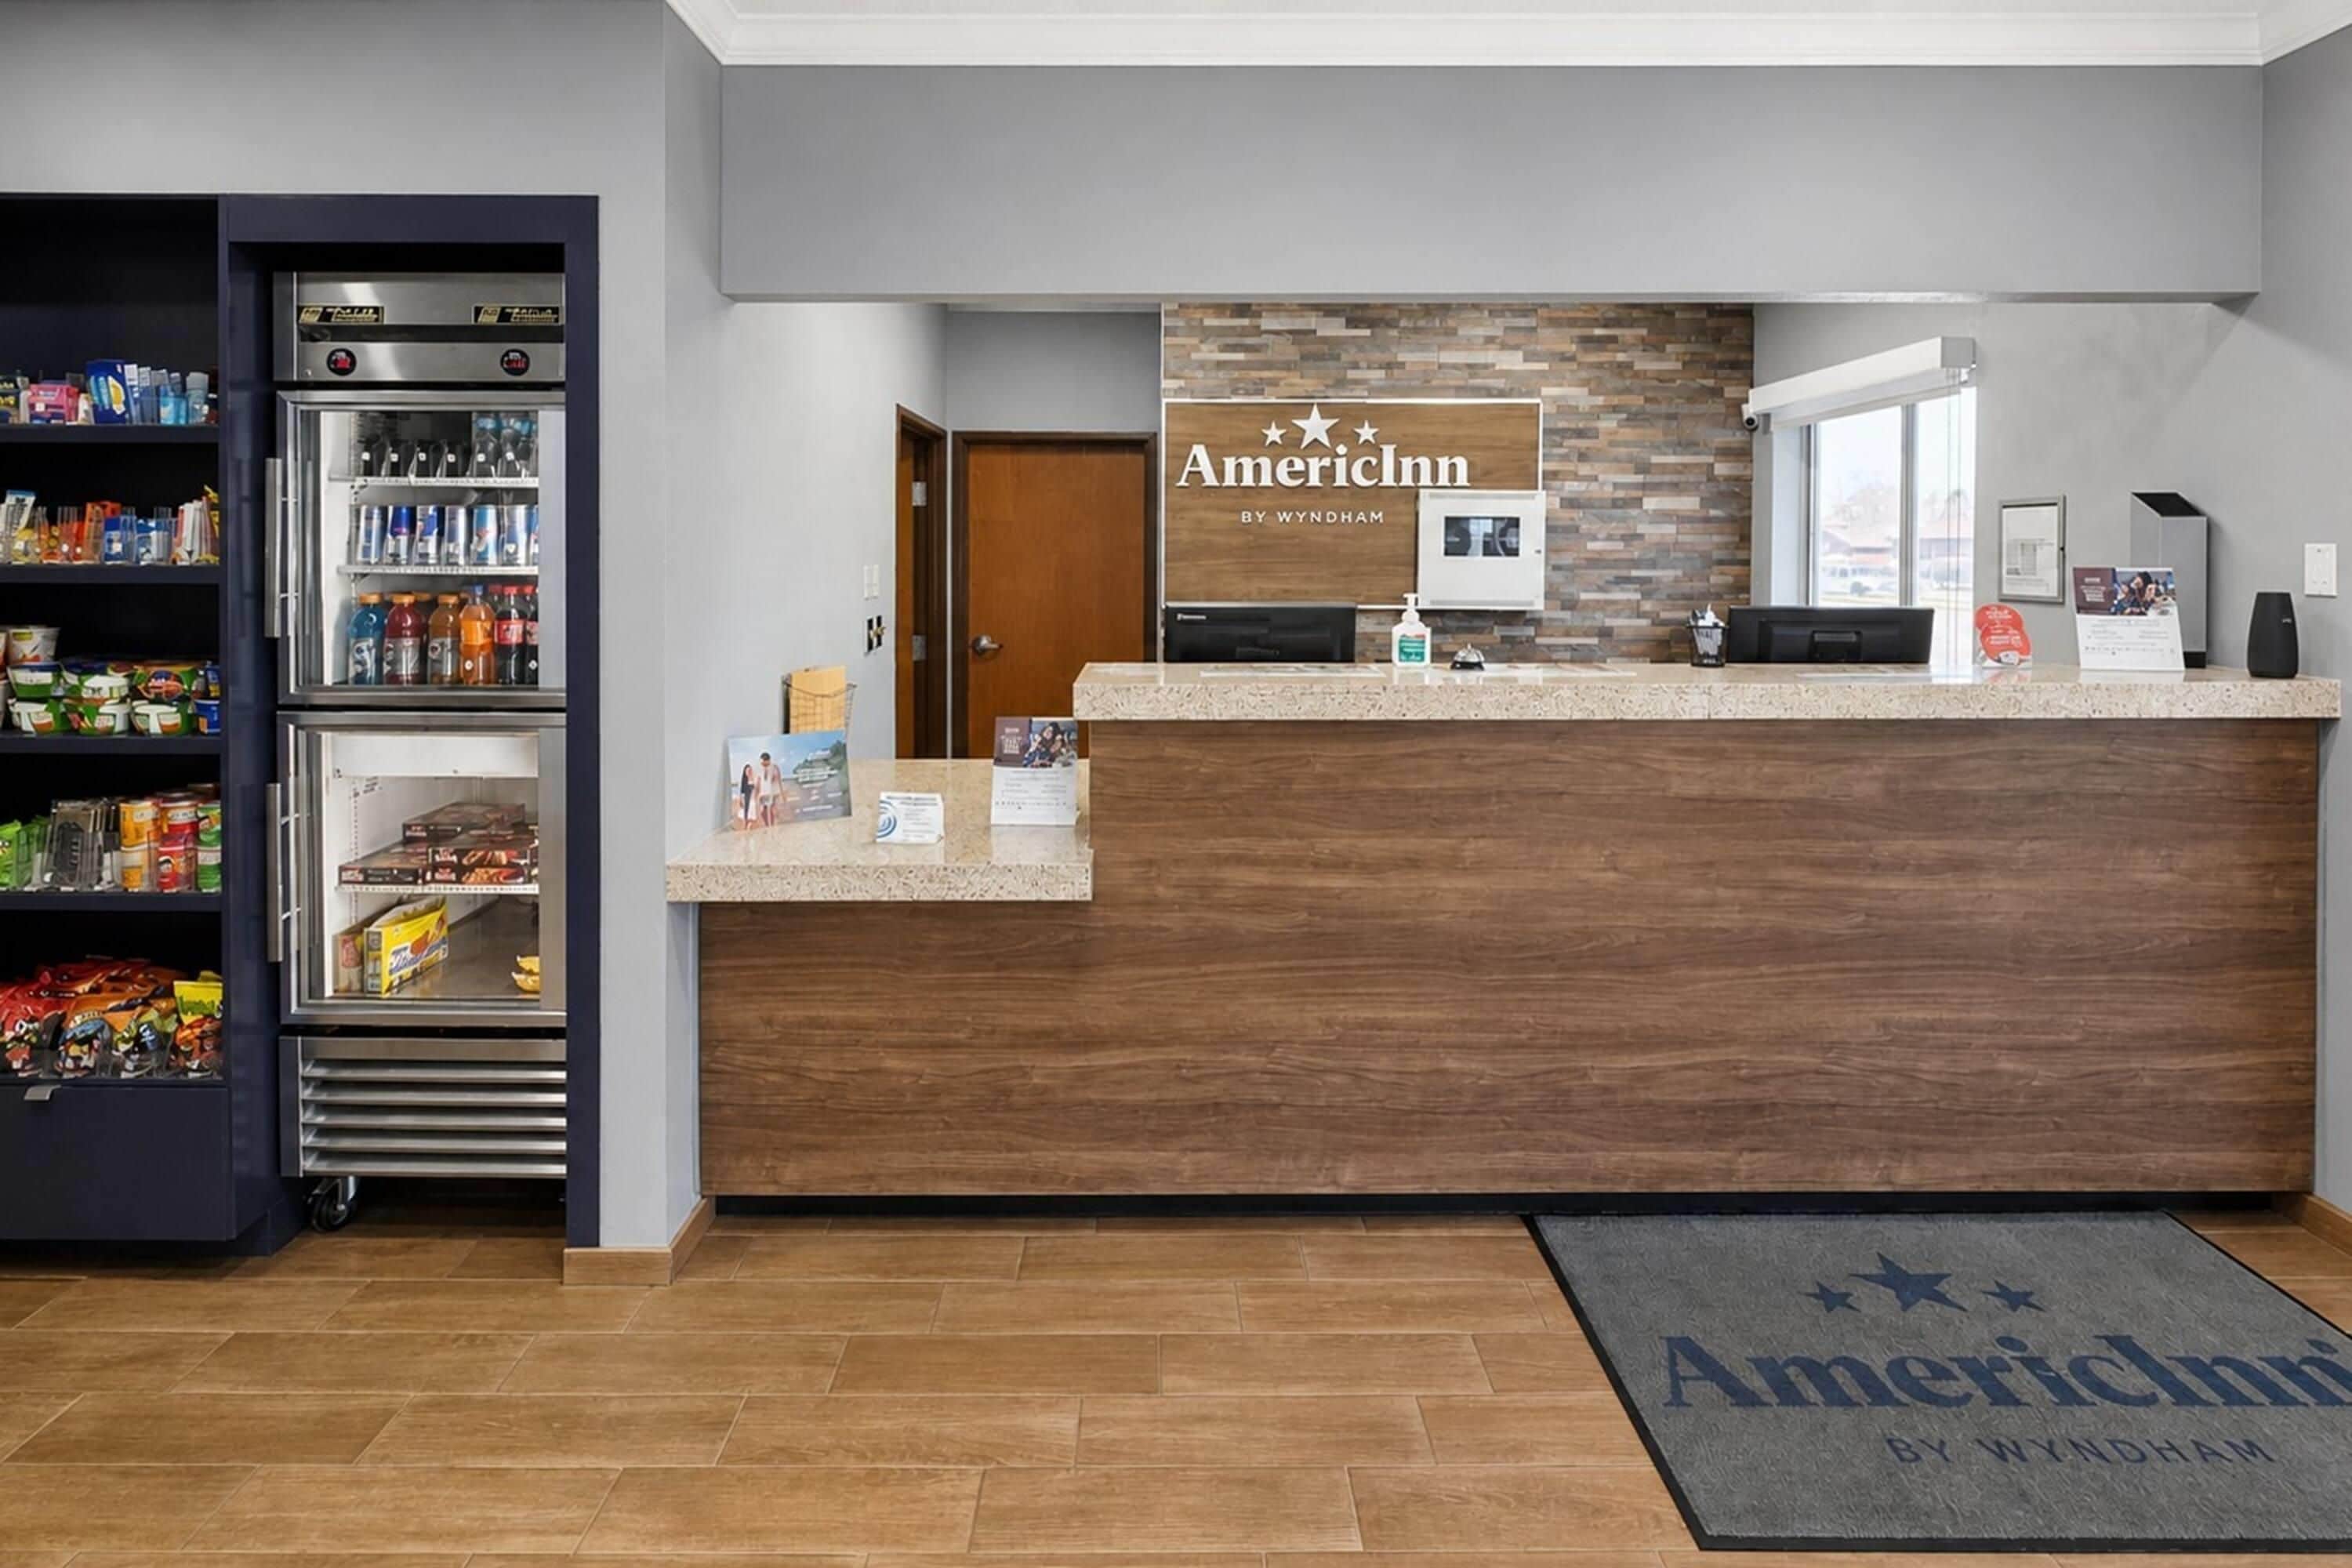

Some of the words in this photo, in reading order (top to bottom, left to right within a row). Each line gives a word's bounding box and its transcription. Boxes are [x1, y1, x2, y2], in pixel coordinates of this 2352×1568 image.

[1176, 443, 1471, 488] AmericInn
[1241, 511, 1267, 523] BY
[1277, 511, 1385, 523] WYNDHAM
[1659, 1334, 2352, 1407] AmericInn
[1886, 1437, 1951, 1464] BY
[1976, 1437, 2275, 1464] WYNDHAM
